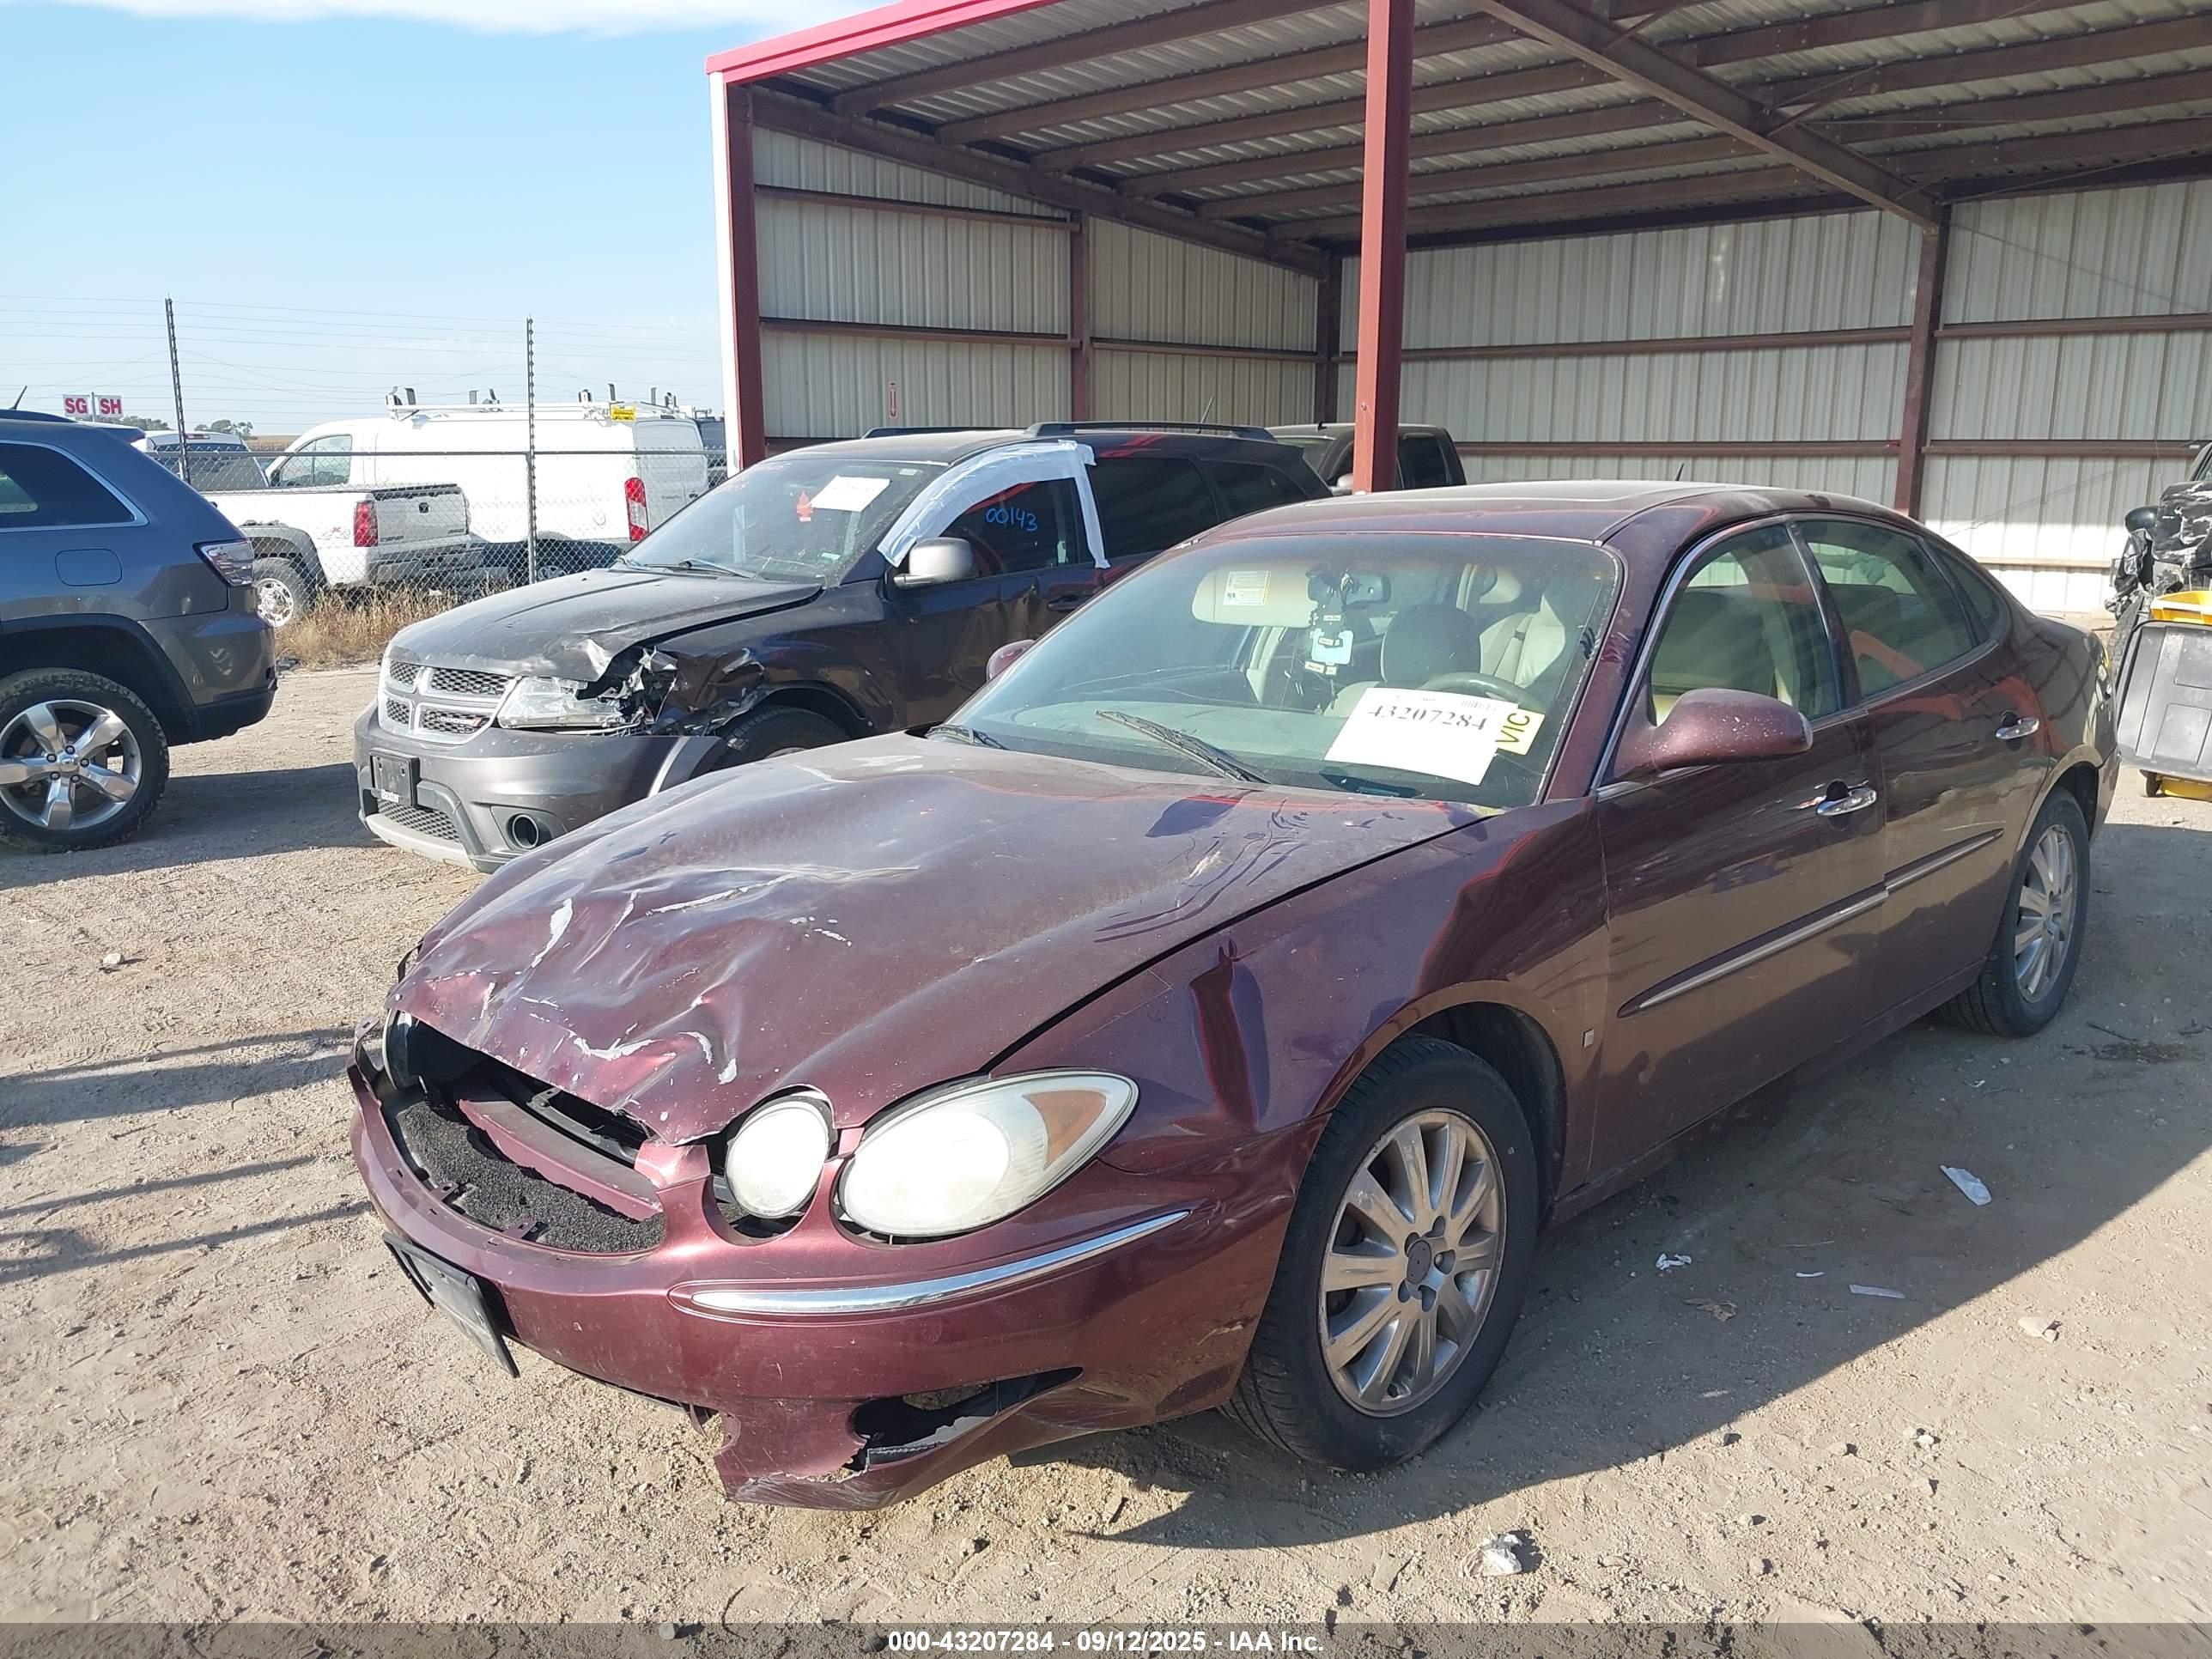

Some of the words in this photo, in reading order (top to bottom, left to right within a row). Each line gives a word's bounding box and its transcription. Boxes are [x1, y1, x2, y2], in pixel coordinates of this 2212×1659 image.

[64, 398, 88, 414] SG
[100, 398, 122, 414] SH
[985, 506, 1038, 532] 00143
[1368, 705, 1487, 731] 43207284
[1495, 712, 1531, 744] VIC
